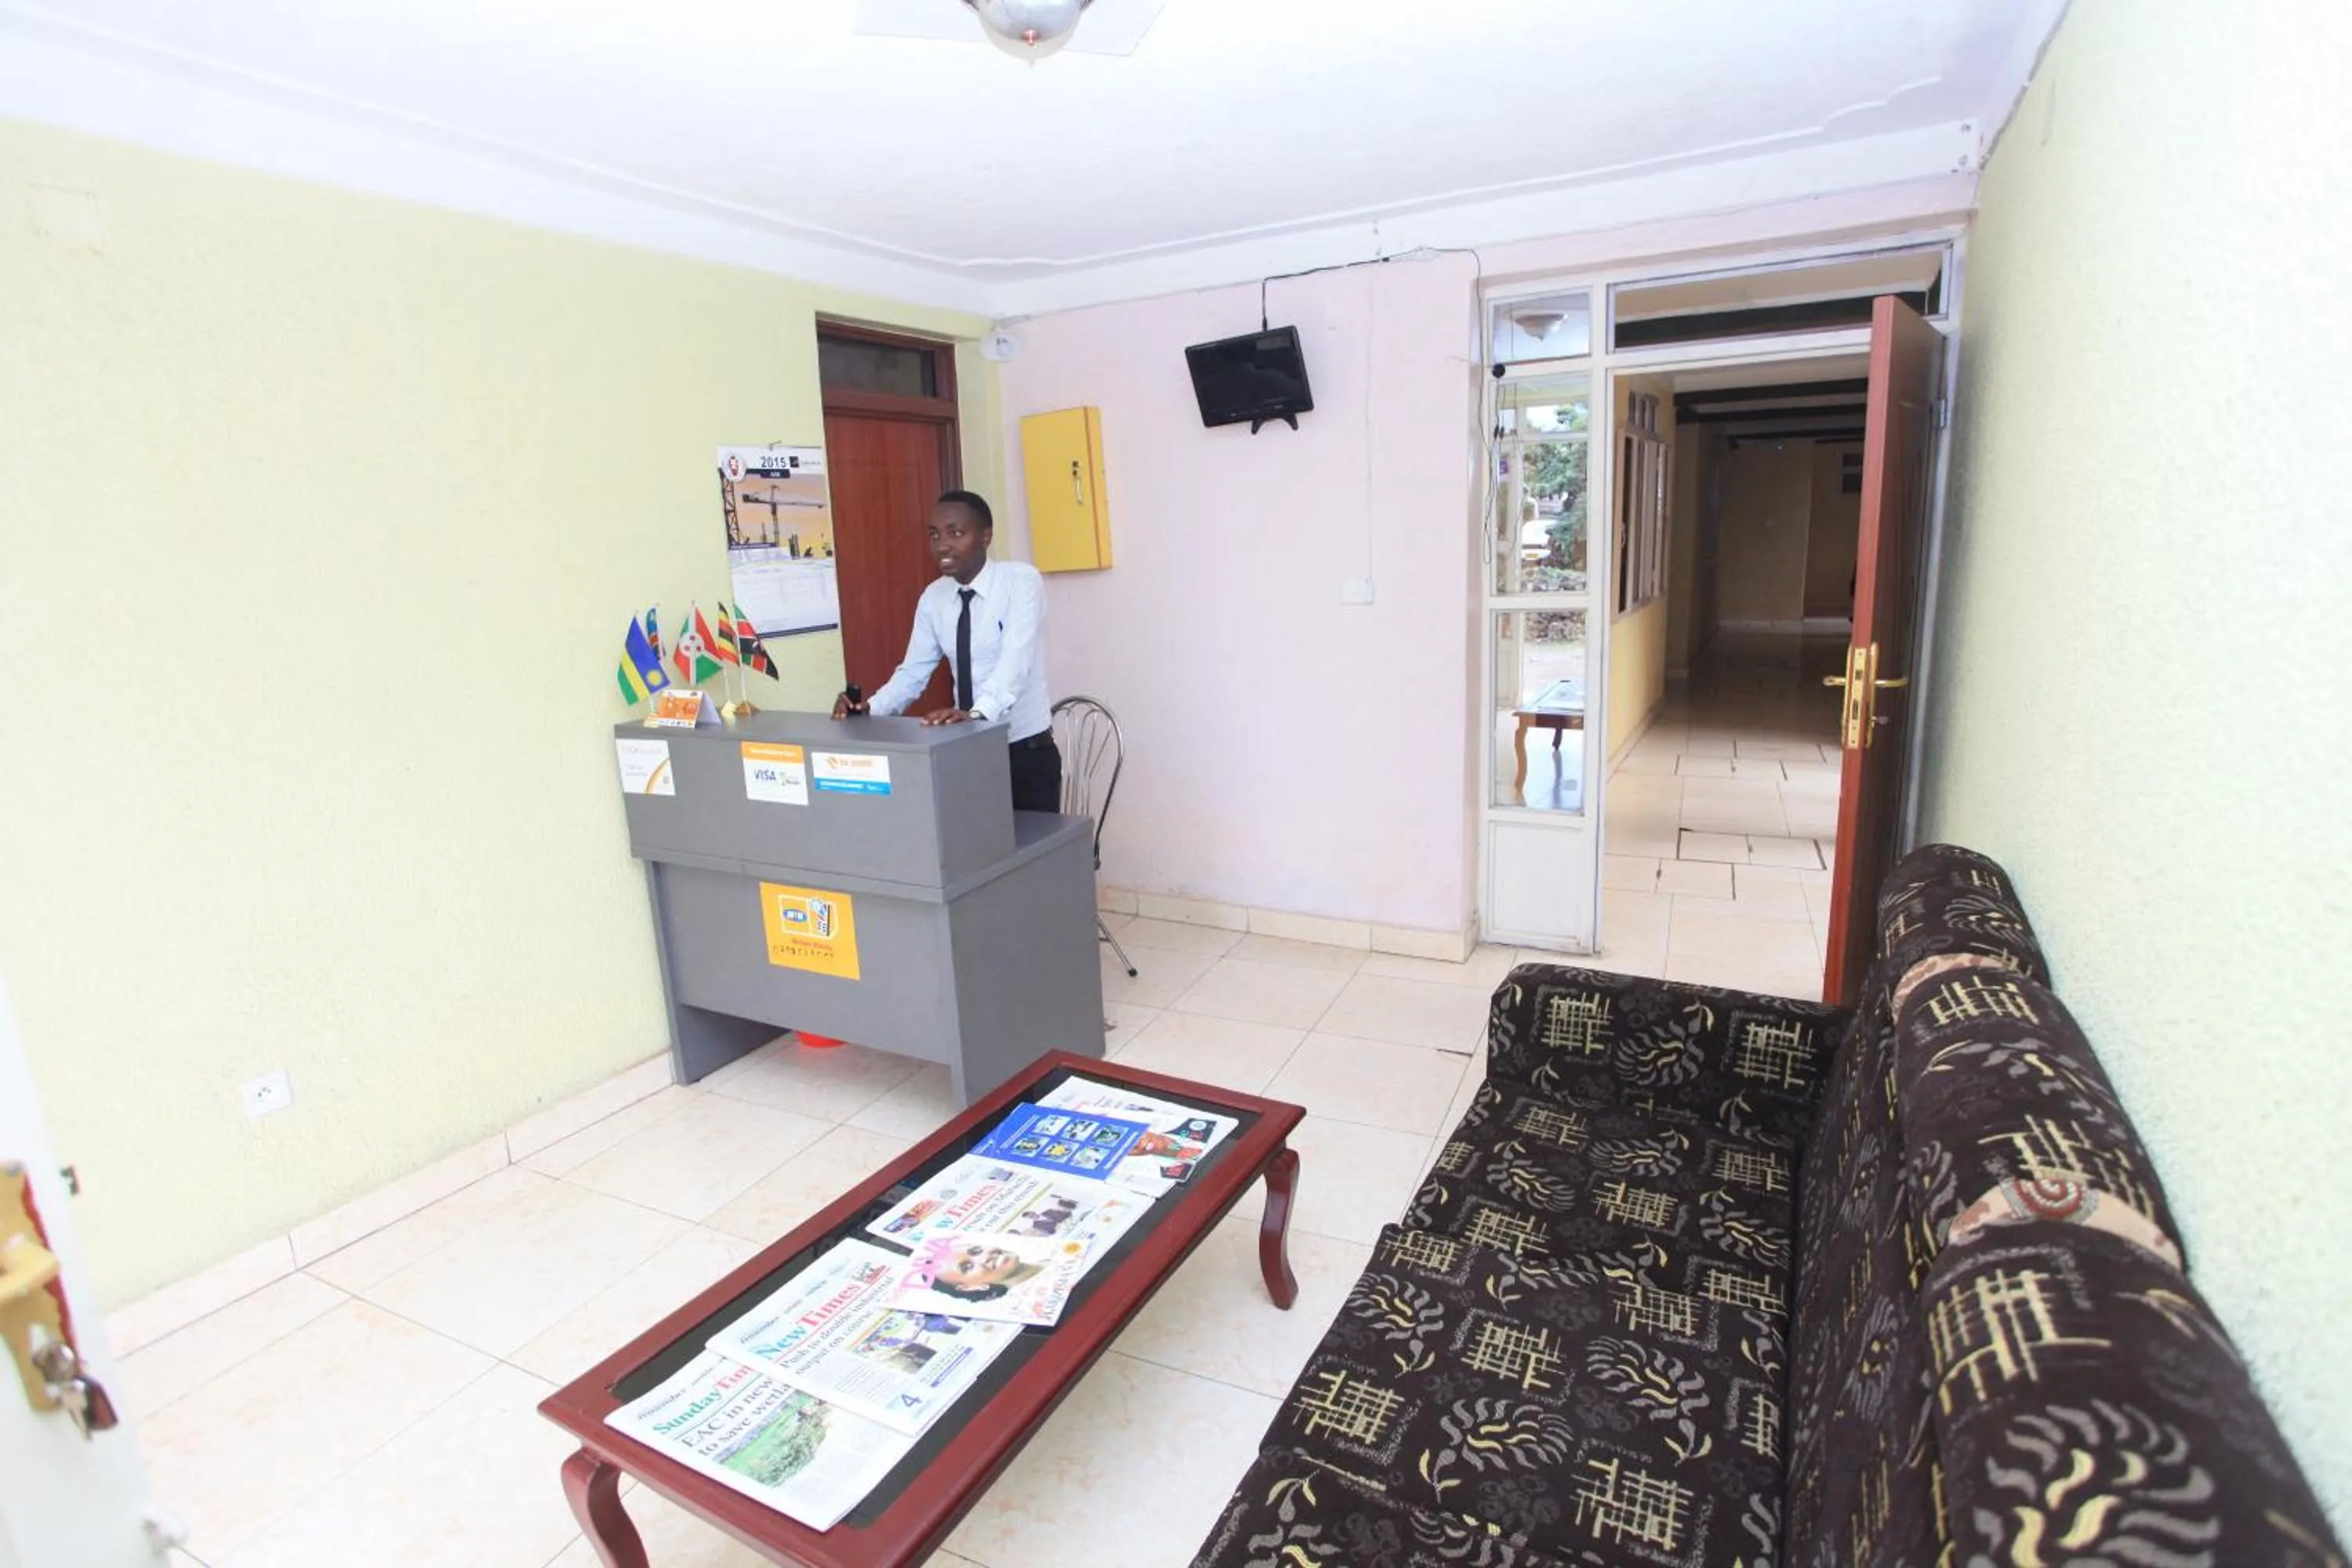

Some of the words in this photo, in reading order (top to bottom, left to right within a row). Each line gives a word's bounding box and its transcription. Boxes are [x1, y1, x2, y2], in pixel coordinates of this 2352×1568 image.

[760, 456, 786, 468] 2015
[754, 769, 776, 782] VISA
[944, 1183, 997, 1217] Times
[749, 1324, 808, 1360] New
[795, 1283, 861, 1327] Times
[652, 1388, 724, 1434] Sunday
[681, 1418, 724, 1448] EAC
[726, 1403, 743, 1420] in
[742, 1377, 775, 1405] new
[902, 1393, 922, 1407] 4
[698, 1443, 718, 1457] to
[722, 1418, 751, 1443] save
